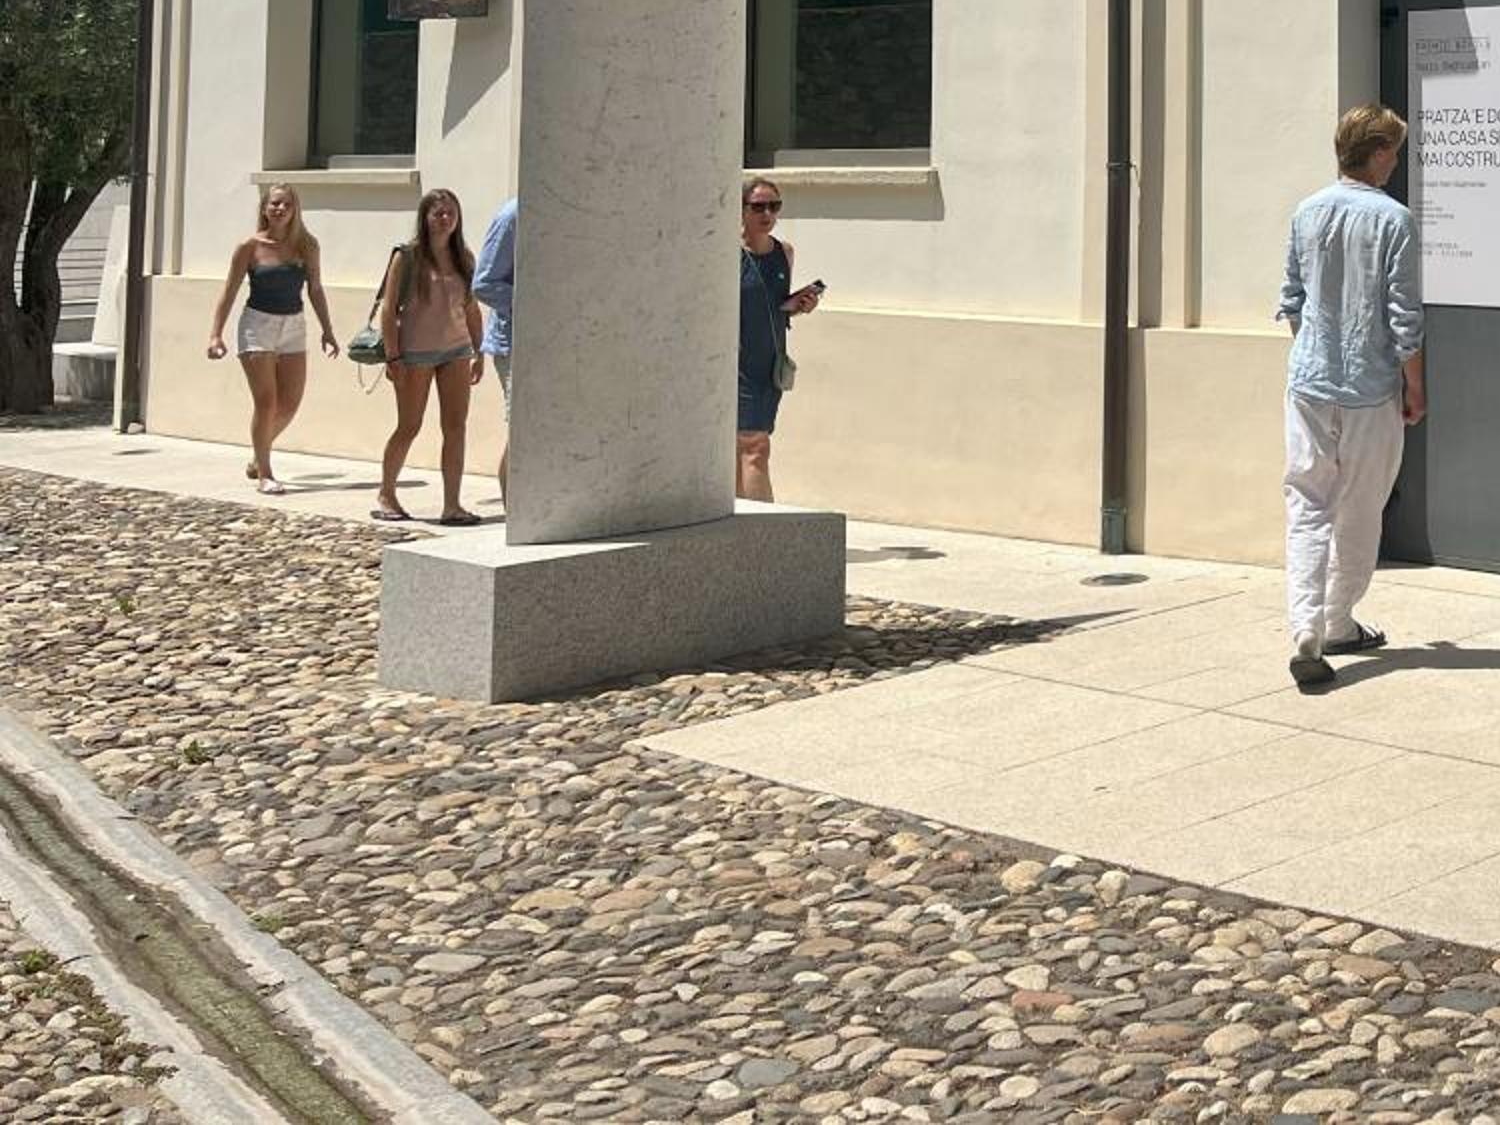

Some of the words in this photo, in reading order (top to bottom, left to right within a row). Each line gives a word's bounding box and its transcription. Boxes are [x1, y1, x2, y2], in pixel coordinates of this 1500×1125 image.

[1417, 108, 1471, 124] PRATZA
[1417, 130, 1446, 145] UNA
[1449, 130, 1486, 145] CASA
[1417, 151, 1443, 167] MAI
